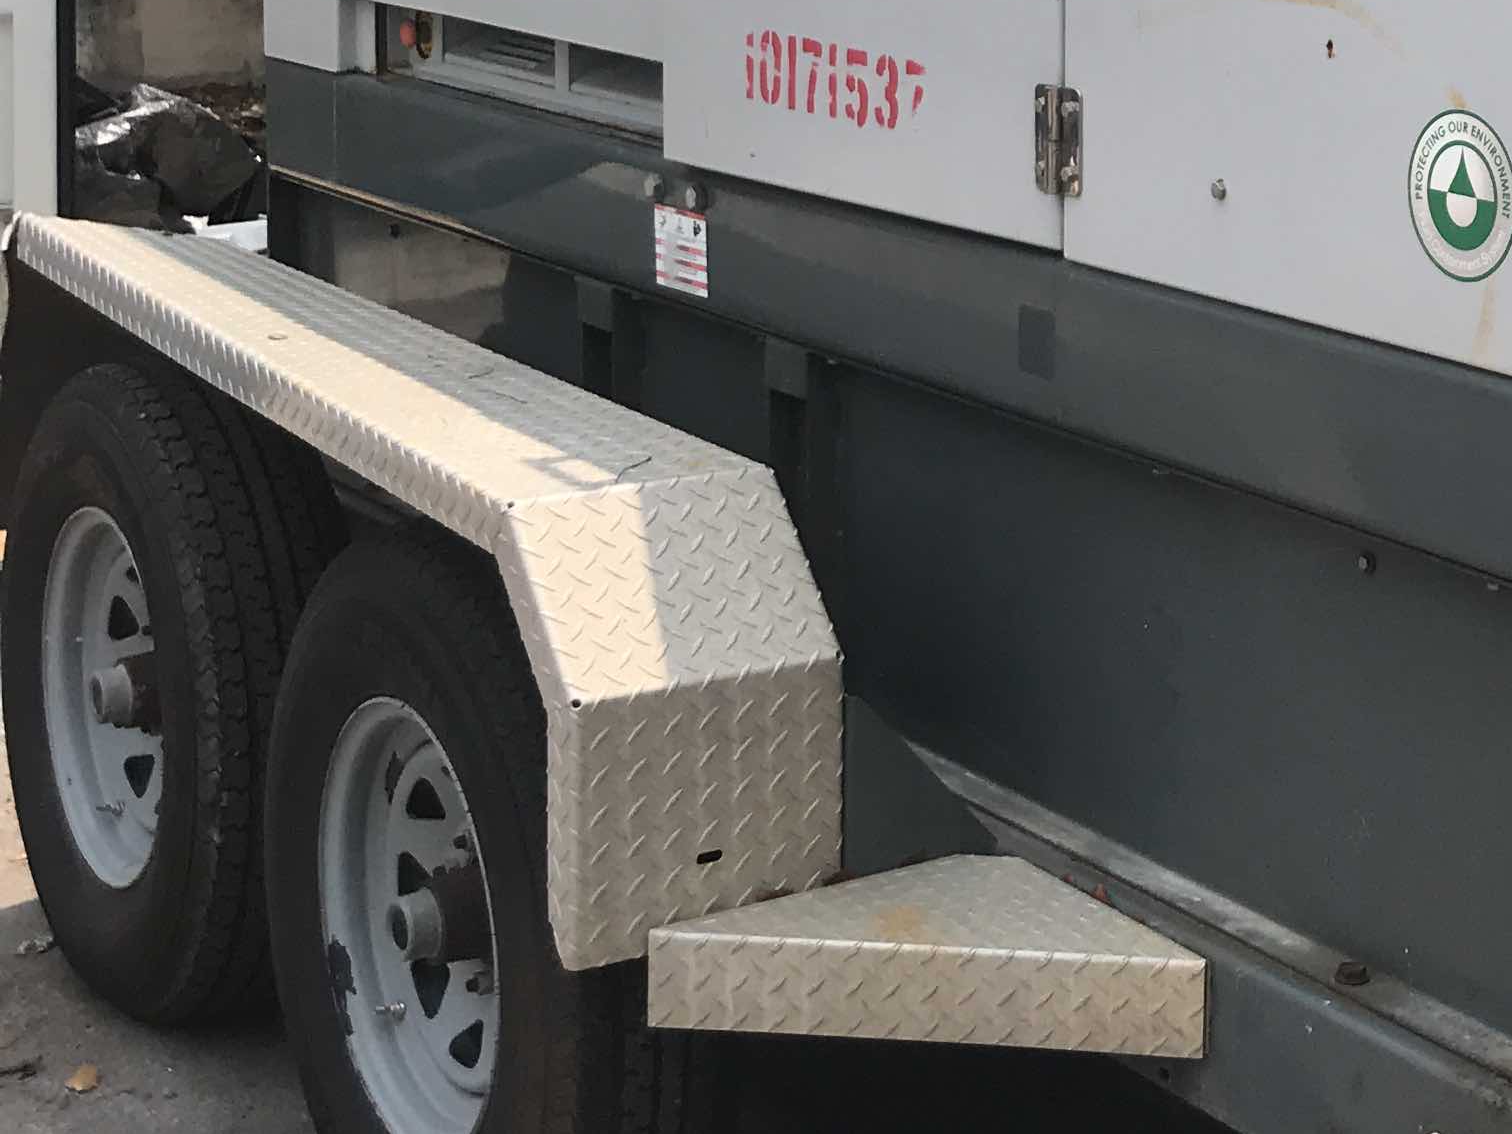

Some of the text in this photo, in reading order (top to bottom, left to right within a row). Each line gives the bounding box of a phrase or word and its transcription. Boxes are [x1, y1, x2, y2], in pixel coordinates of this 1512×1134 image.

[744, 28, 927, 132] 10171537
[1415, 120, 1512, 220] PROTECTING OUR ENVIRONMENT
